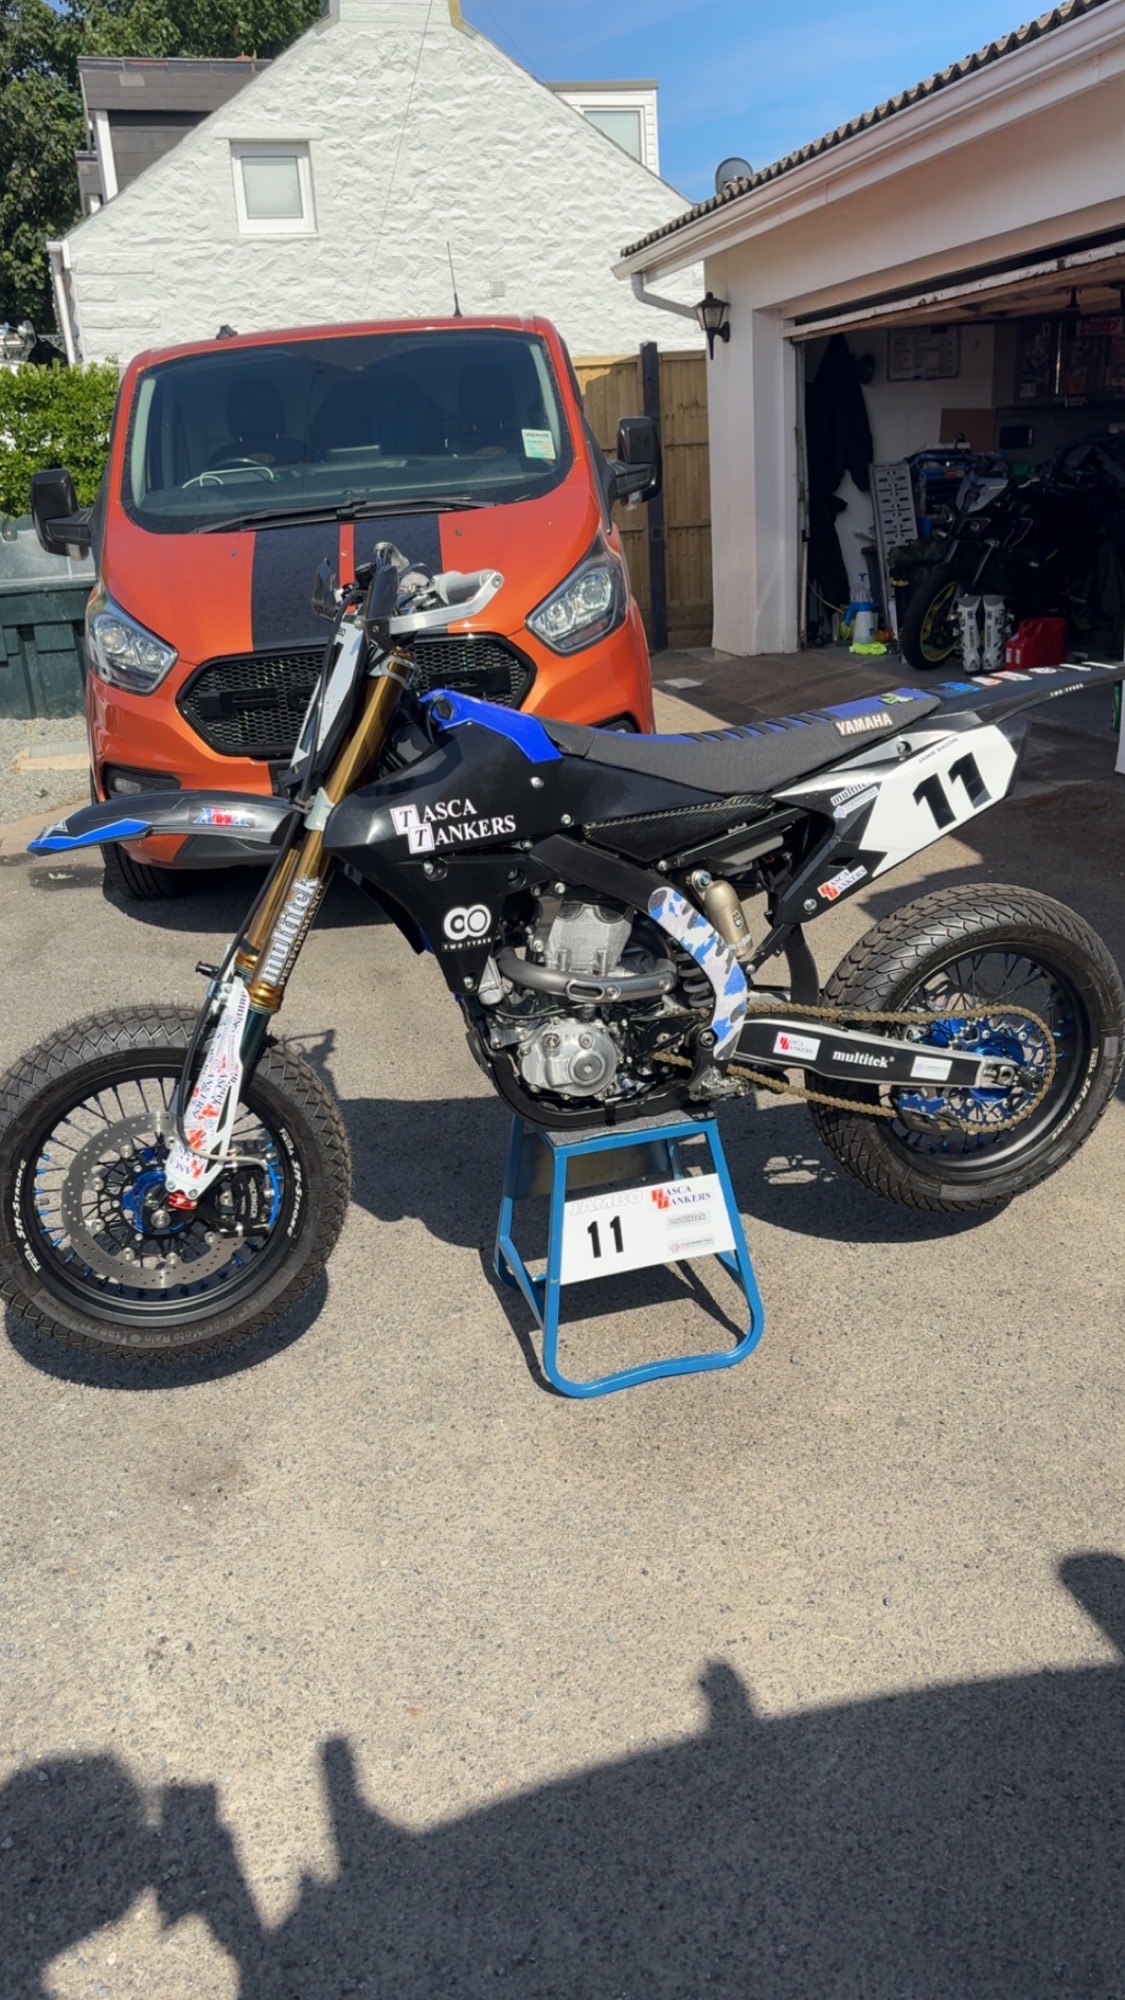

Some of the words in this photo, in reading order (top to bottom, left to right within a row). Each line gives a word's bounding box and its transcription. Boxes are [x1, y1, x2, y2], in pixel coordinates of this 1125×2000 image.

[835, 711, 894, 736] YAMAHA
[831, 782, 870, 805] multite
[913, 752, 993, 830] 11
[261, 874, 320, 986] multitek
[569, 1190, 643, 1217] JAMBO
